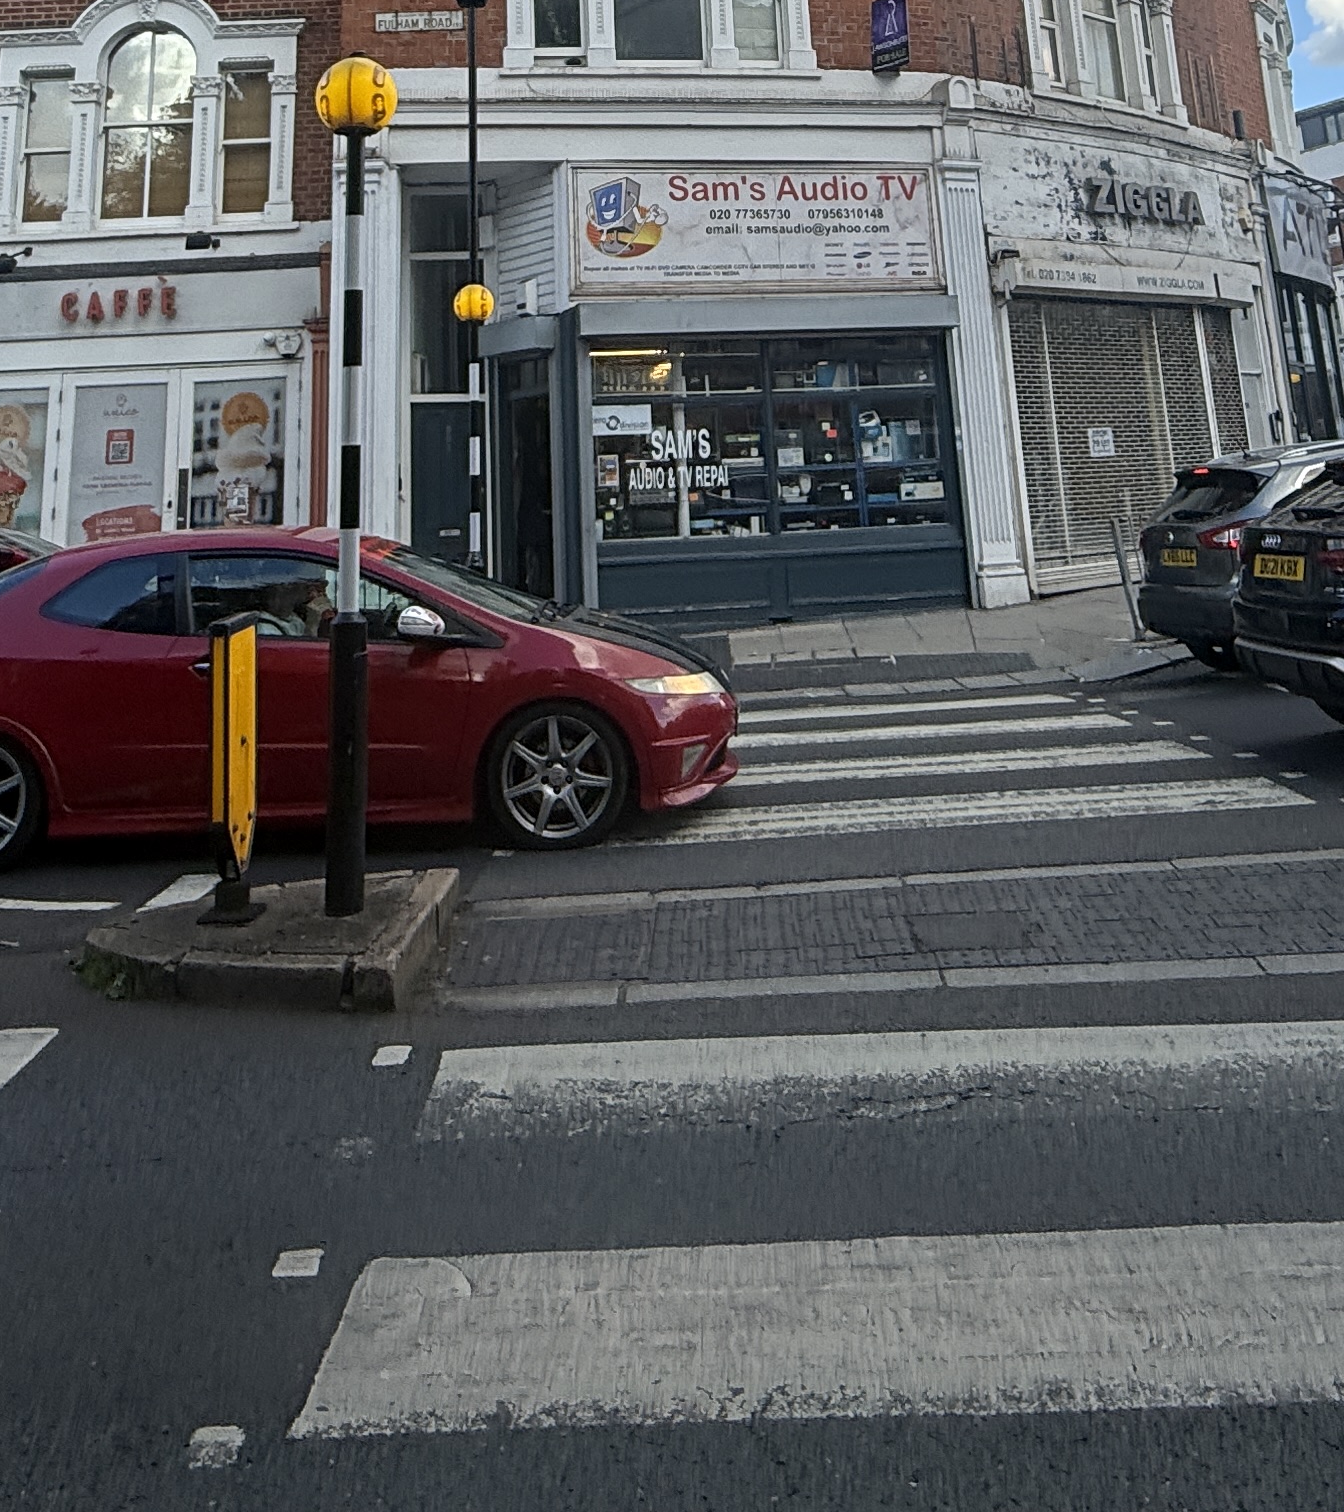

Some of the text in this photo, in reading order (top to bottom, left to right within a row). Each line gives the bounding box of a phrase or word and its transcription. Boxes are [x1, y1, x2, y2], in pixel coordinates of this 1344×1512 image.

[378, 18, 419, 29] FULHAM
[424, 17, 452, 28] ROAD
[668, 175, 918, 201] Sam's Audio TV
[1087, 177, 1206, 225] ZIGGLA
[709, 208, 884, 220] 020 77365730 07956310148
[706, 223, 890, 236] email: samsaudio@yahoo.com
[61, 276, 177, 322] CAFFÈ
[651, 428, 711, 460] SAM'S
[629, 467, 665, 490] AUDIO
[668, 467, 676, 488] &
[678, 466, 693, 488] TV
